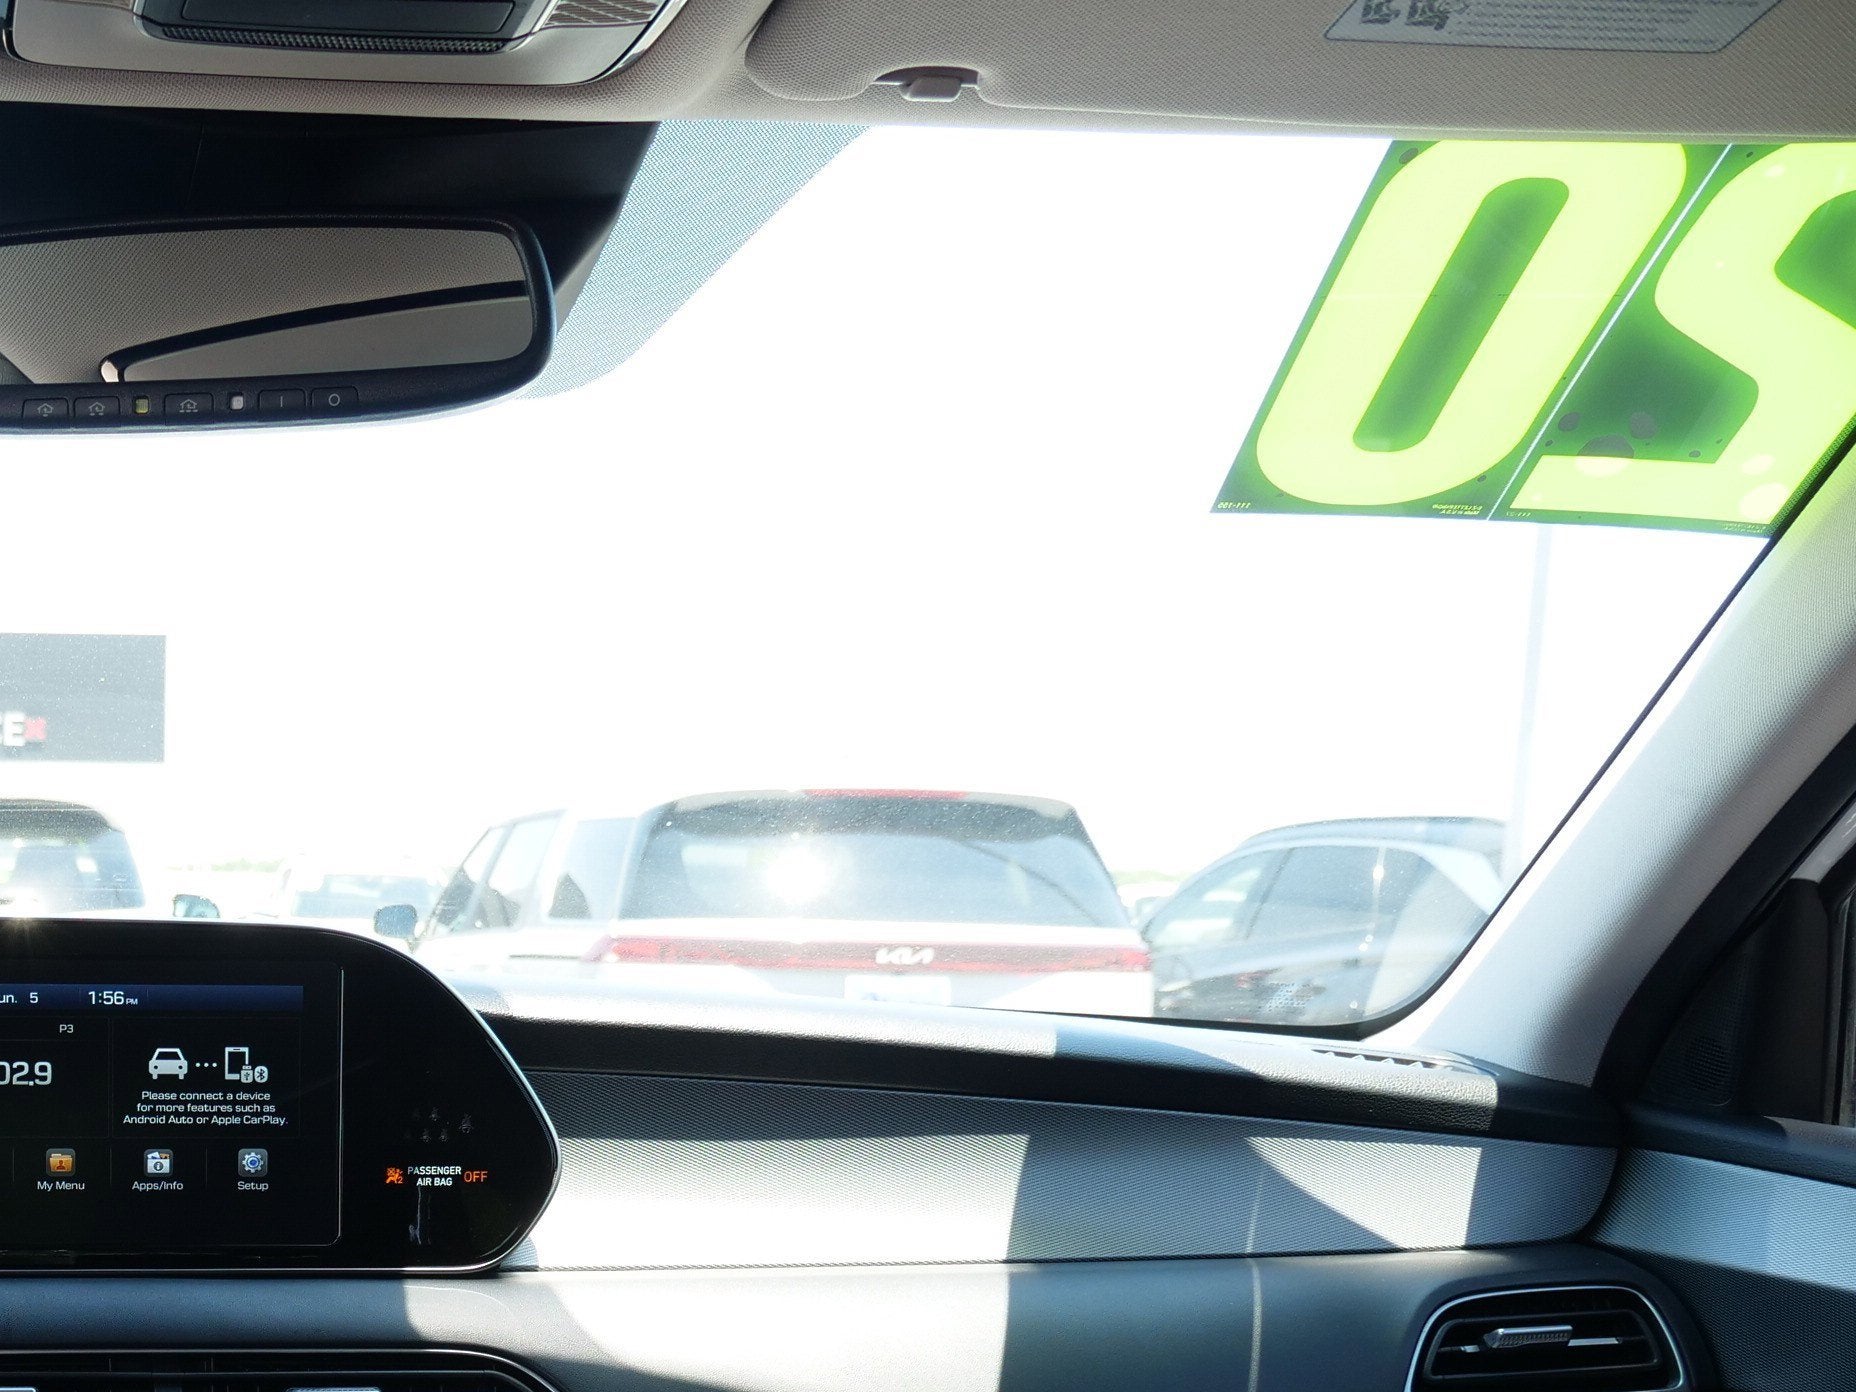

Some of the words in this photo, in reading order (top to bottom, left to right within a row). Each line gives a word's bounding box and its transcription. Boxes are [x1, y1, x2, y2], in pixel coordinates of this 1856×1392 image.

[29, 992, 39, 1004] 5
[59, 1024, 74, 1034] P3
[141, 1091, 177, 1100] Please
[179, 1091, 223, 1100] connect
[236, 1091, 271, 1100] device
[137, 1103, 153, 1112] for
[187, 1103, 233, 1112] features
[235, 1103, 261, 1112] such
[123, 1115, 166, 1124] Android
[168, 1115, 194, 1124] Auto
[211, 1115, 241, 1125] Apple
[243, 1115, 289, 1126] CarPlay.
[407, 1166, 462, 1175] PASSENGER
[416, 1177, 432, 1186] AIR
[434, 1177, 453, 1186] BAG
[464, 1171, 488, 1182] OFF
[37, 1181, 52, 1192] My
[55, 1181, 85, 1190] Menu
[132, 1181, 184, 1191] Apps/Info
[237, 1181, 269, 1191] Setup
